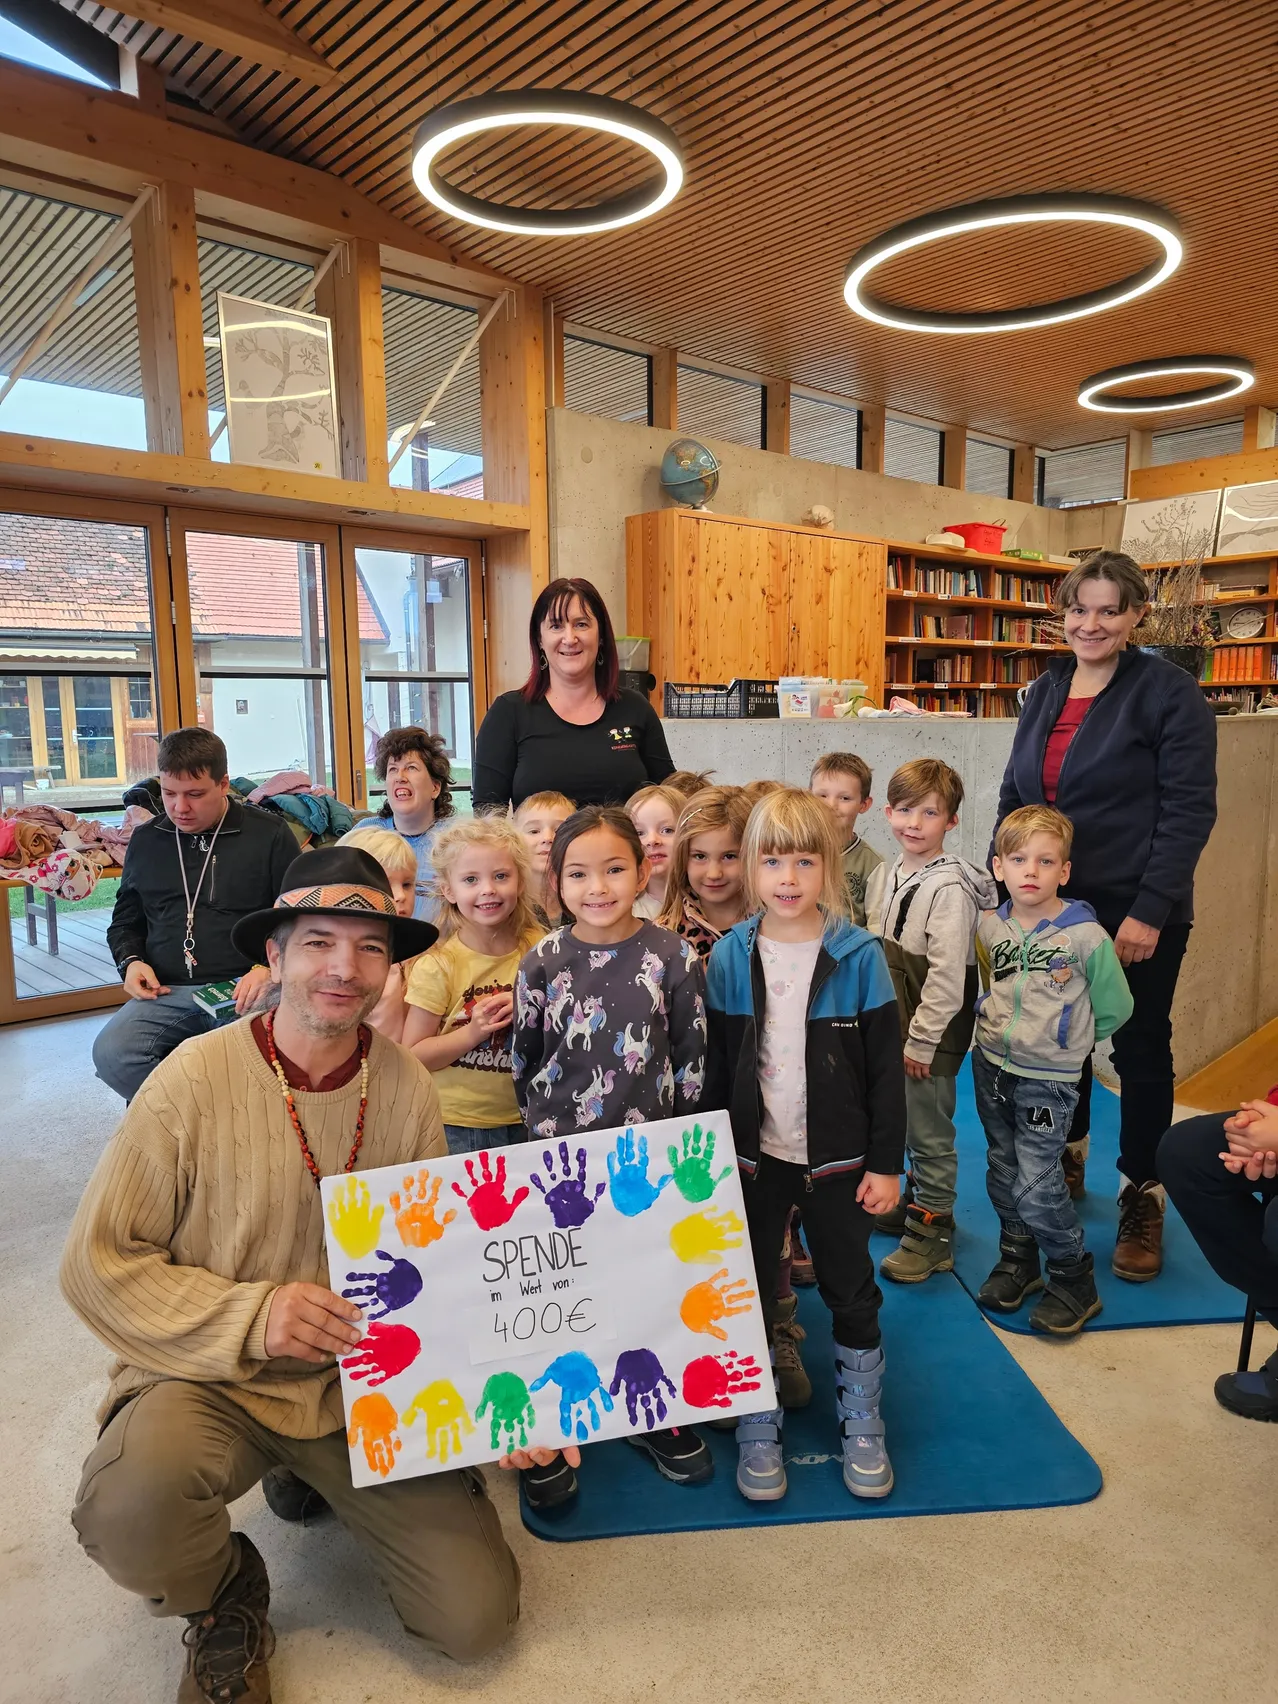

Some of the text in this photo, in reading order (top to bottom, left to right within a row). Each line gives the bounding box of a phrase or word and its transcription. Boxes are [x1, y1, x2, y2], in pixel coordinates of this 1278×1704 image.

[1025, 1106, 1055, 1128] LA
[482, 1227, 588, 1283] SPENDE
[489, 1278, 575, 1302] im Wert von:
[494, 1297, 597, 1343] 400€
